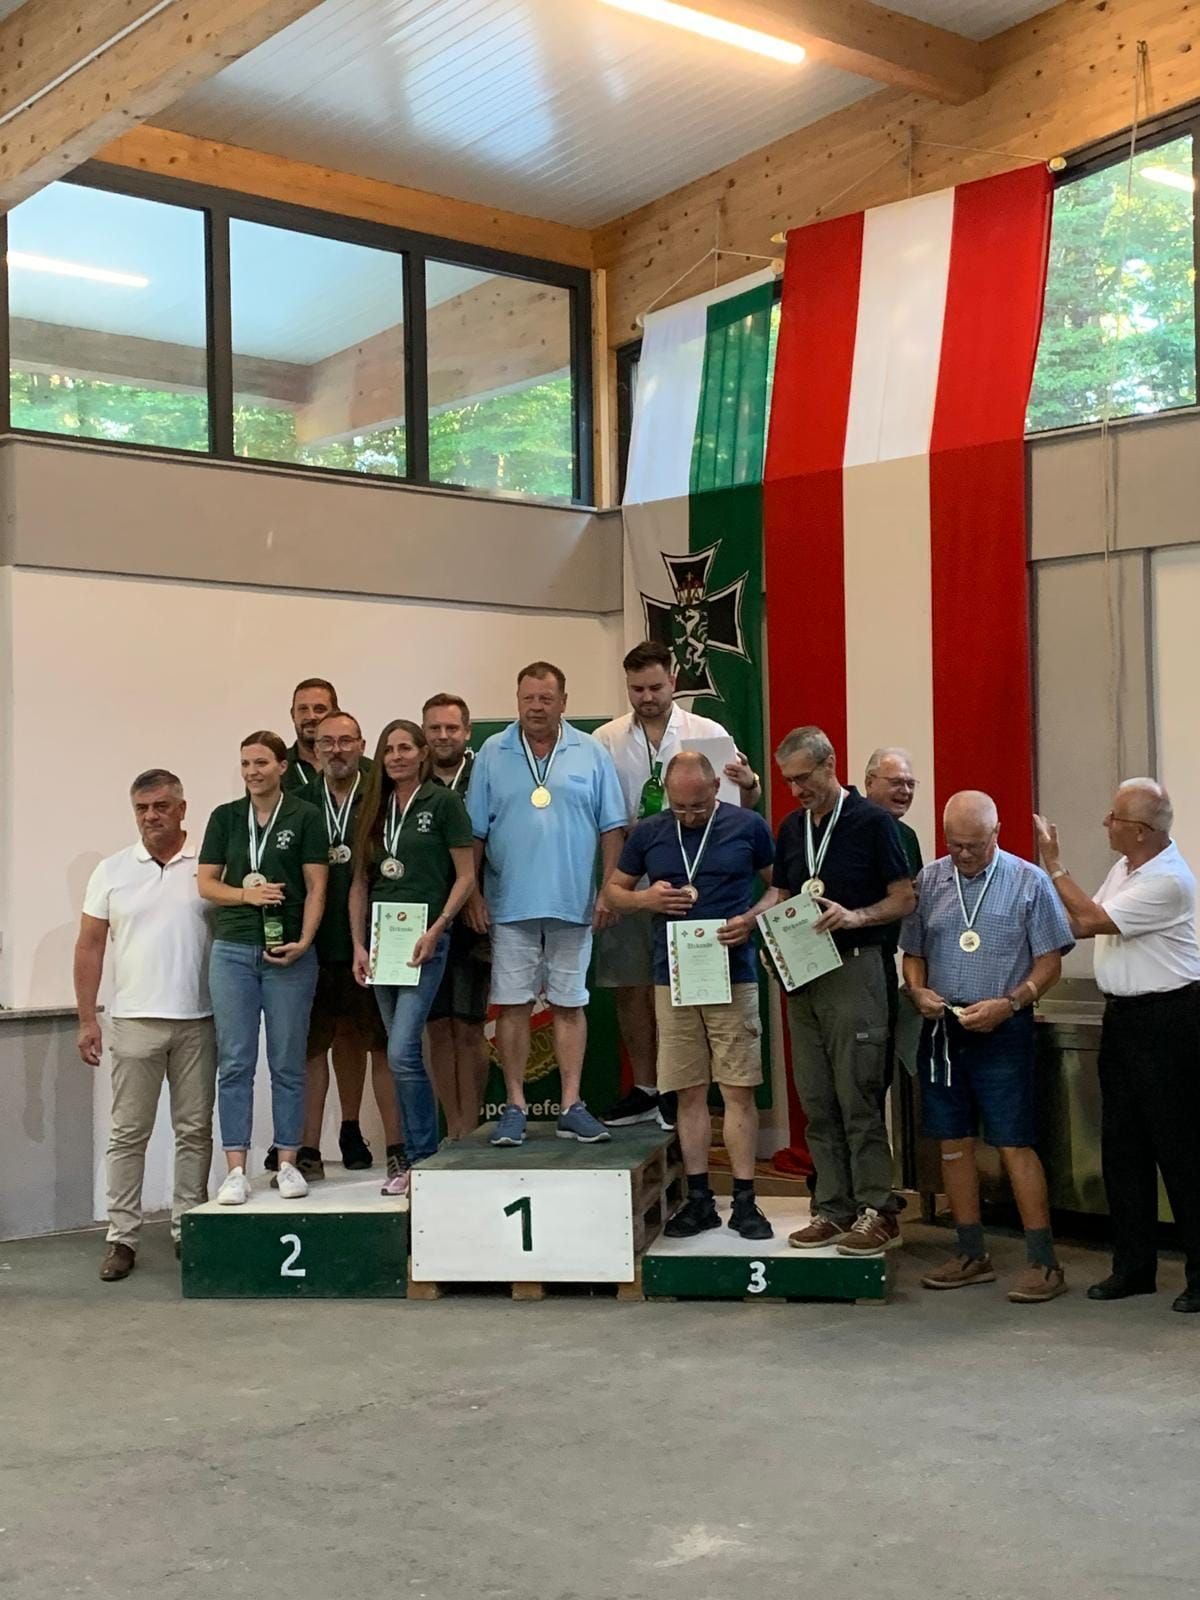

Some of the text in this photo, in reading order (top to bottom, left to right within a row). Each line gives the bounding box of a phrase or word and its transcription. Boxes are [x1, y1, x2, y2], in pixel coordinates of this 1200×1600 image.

[503, 1196, 533, 1252] 1
[279, 1233, 306, 1277] 2
[747, 1261, 768, 1293] 3
